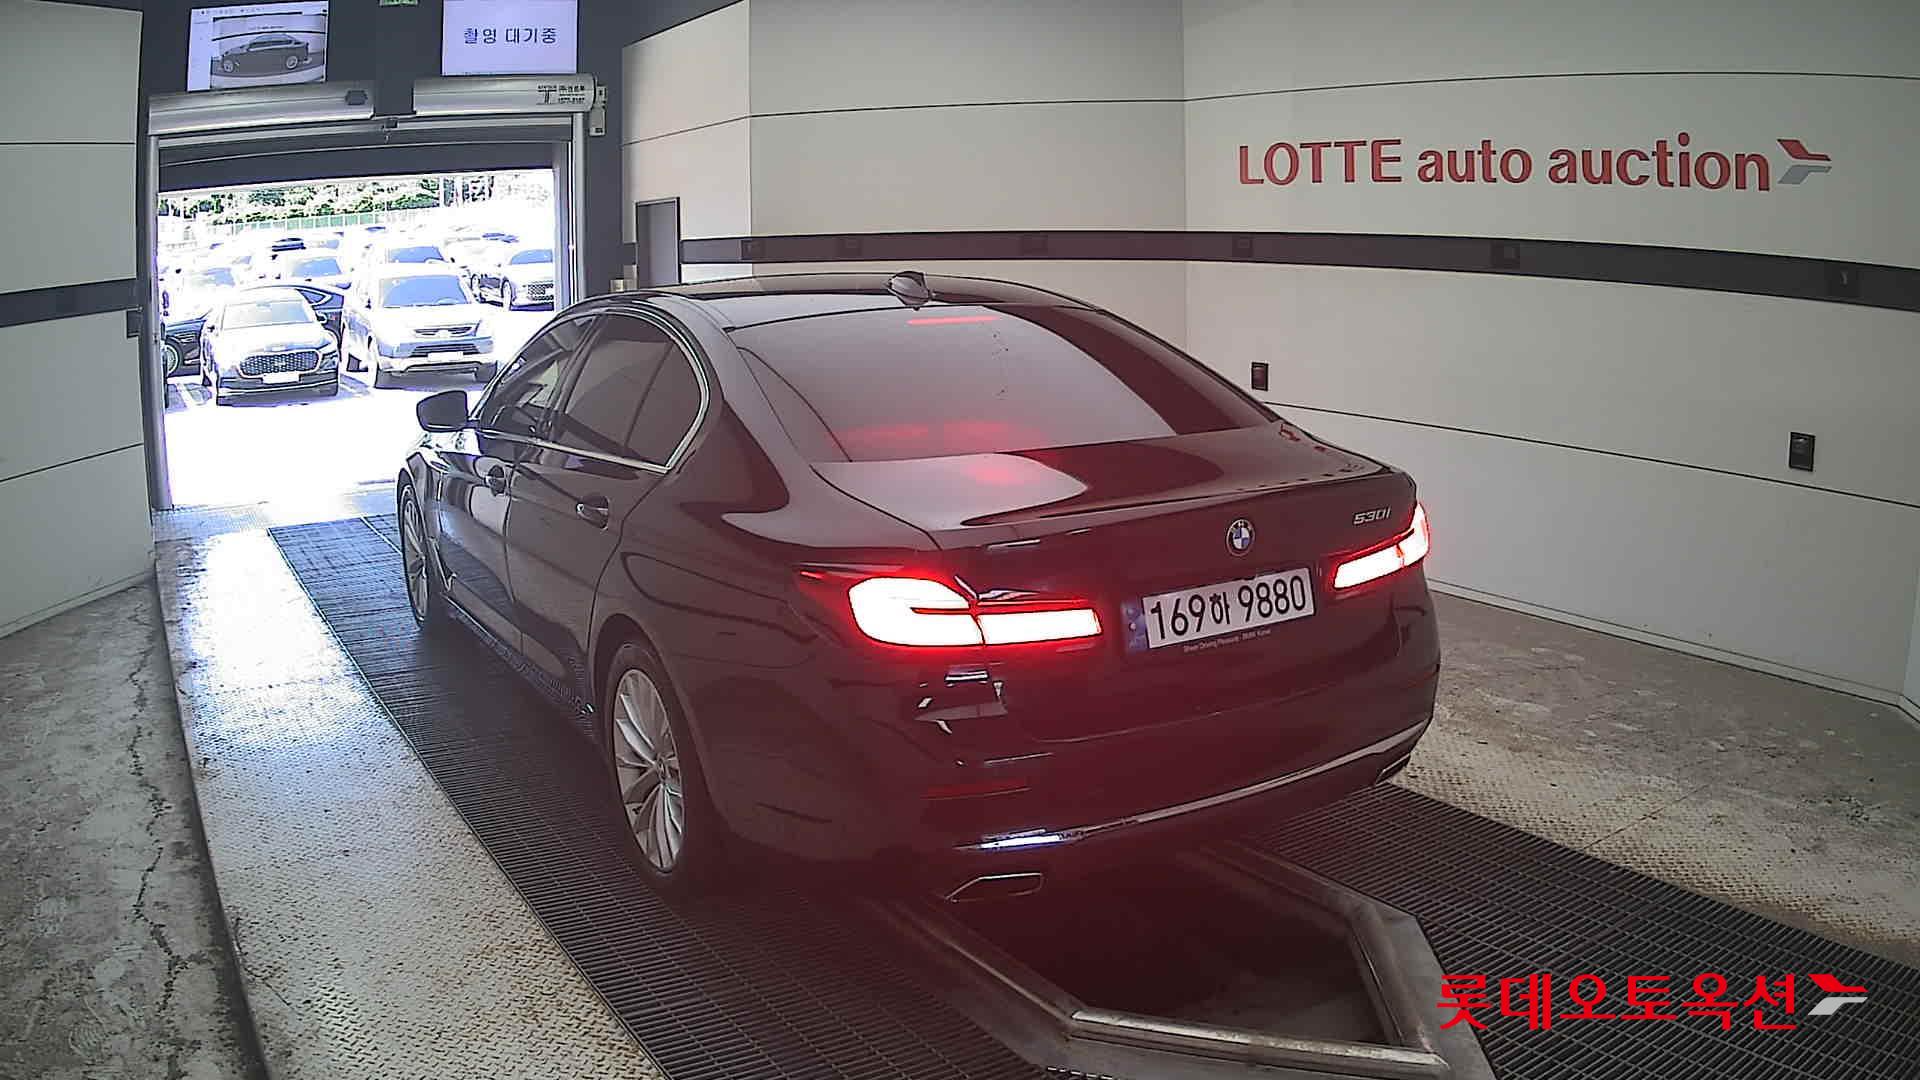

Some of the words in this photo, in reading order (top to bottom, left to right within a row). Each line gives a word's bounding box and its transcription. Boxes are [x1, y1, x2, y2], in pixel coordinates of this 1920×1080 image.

[505, 27, 557, 44] 대기중
[1239, 138, 1402, 184] LOTTE
[1417, 139, 1533, 184] auto
[1547, 131, 1772, 192] auction
[1150, 593, 1231, 640] 169하
[1237, 575, 1306, 622] 9880
